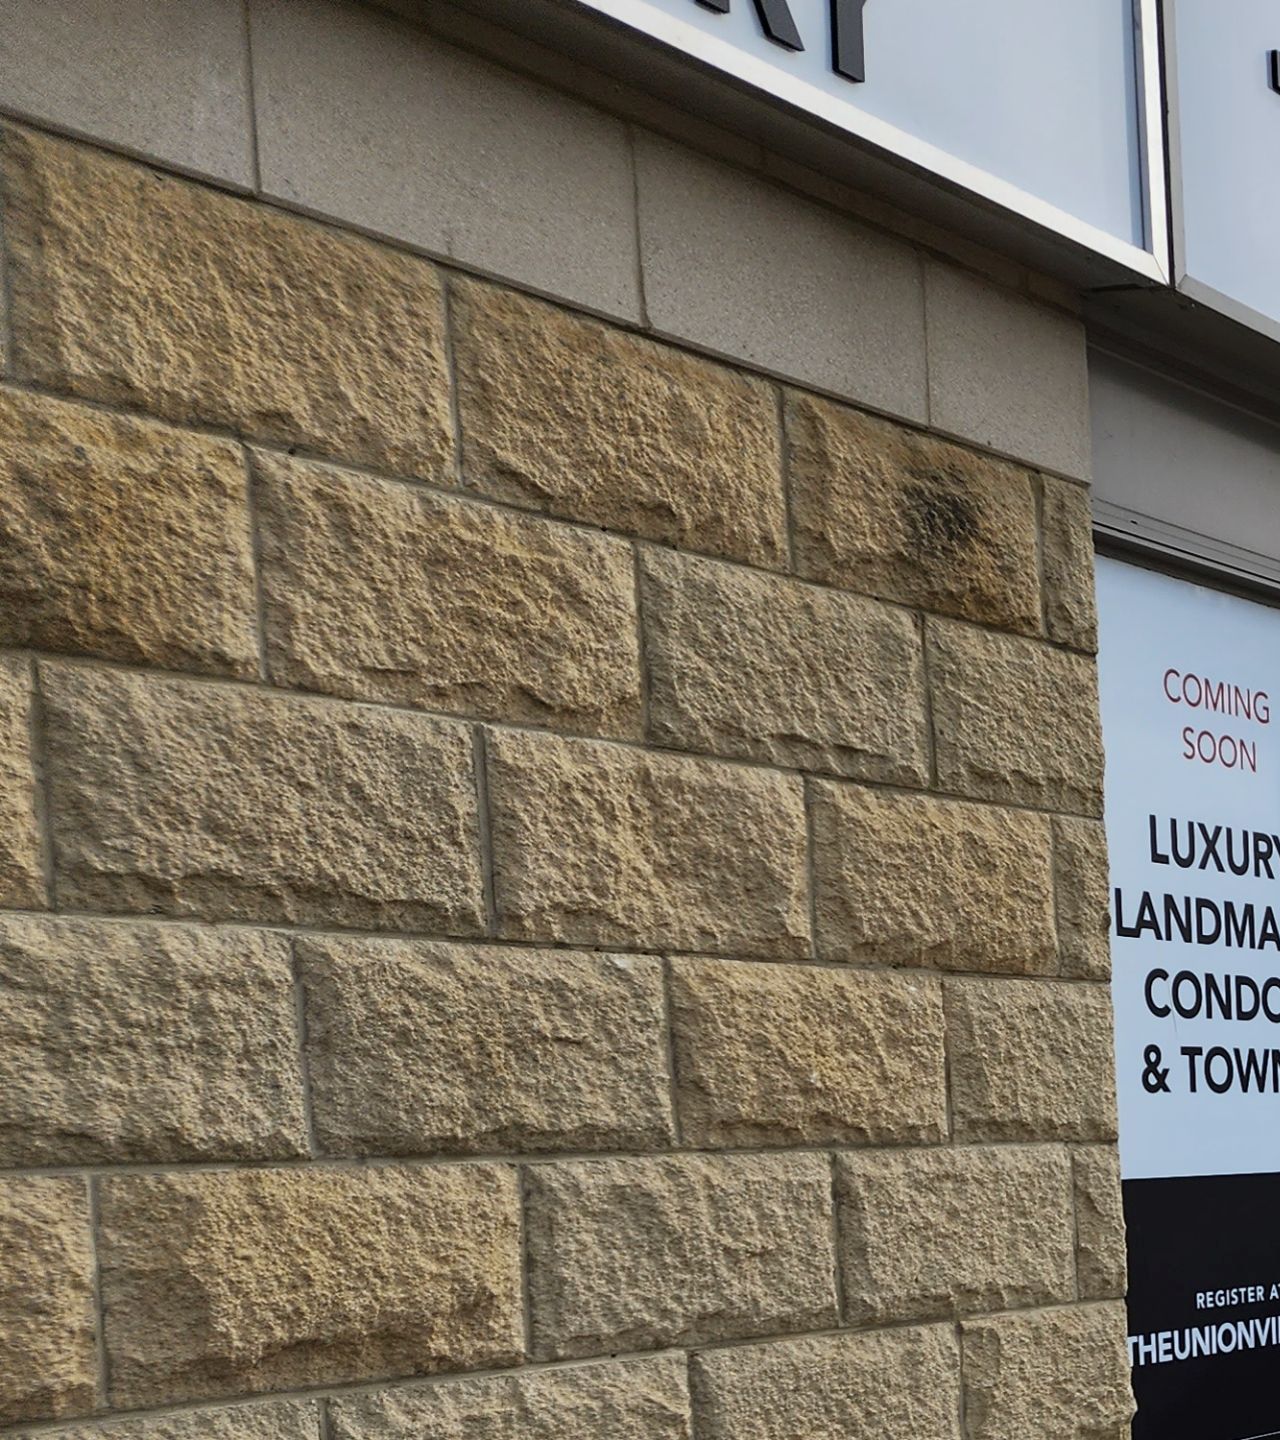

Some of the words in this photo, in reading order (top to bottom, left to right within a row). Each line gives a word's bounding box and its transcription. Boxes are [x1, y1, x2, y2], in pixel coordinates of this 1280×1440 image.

[1163, 668, 1270, 724] COMING
[1182, 726, 1257, 773] SOON
[1142, 1044, 1171, 1094] &
[1196, 1285, 1265, 1309] REGISTER
